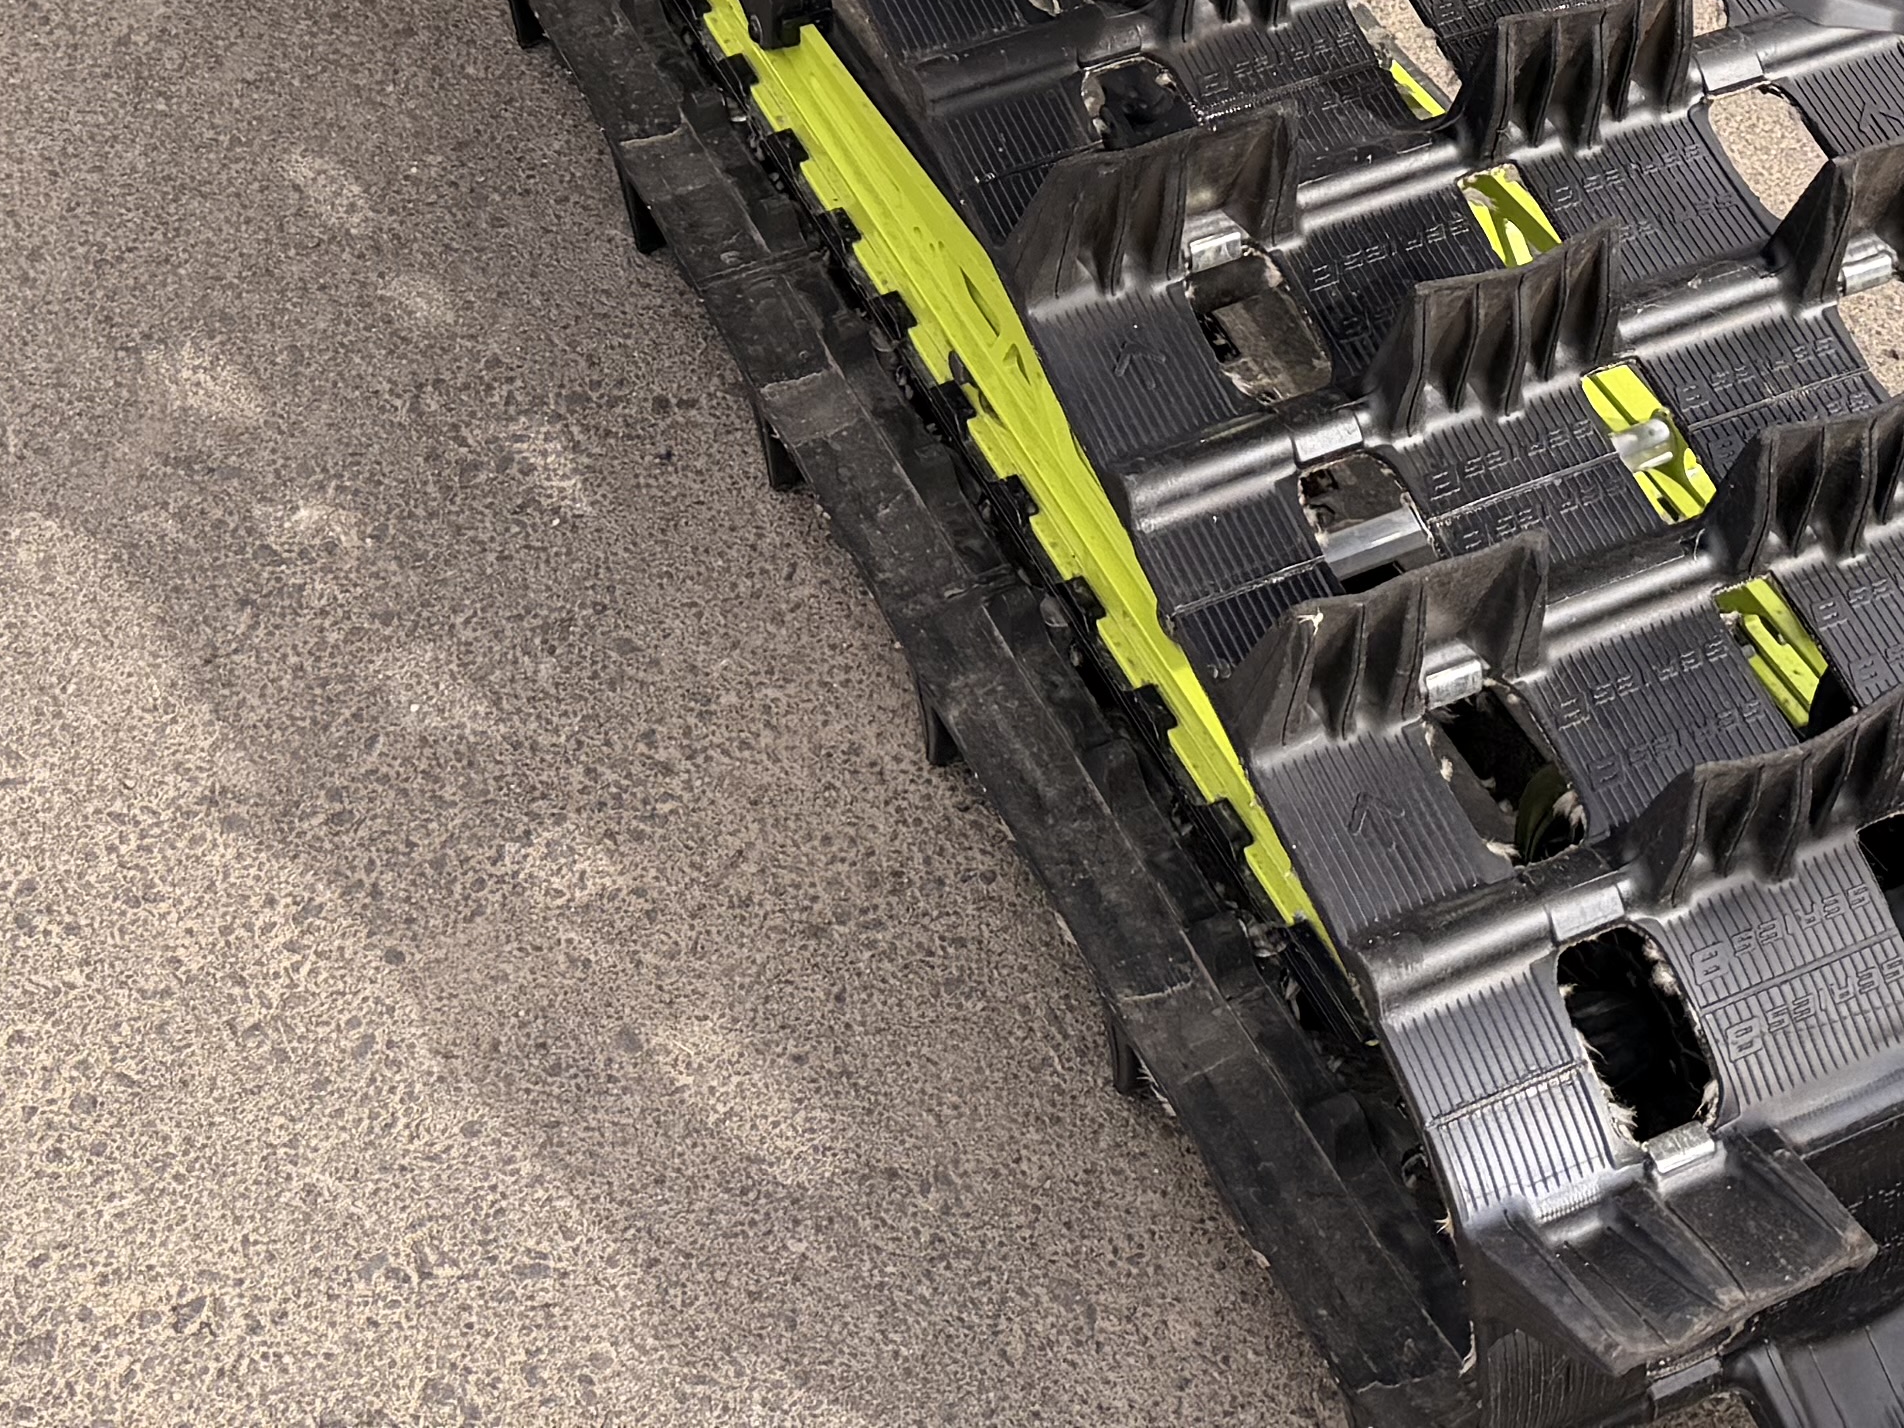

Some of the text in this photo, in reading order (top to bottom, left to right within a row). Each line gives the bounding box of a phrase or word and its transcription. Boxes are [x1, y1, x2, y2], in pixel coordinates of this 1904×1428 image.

[1691, 885, 1872, 986] SERIES 8
[1726, 1016, 1764, 1062] 8
